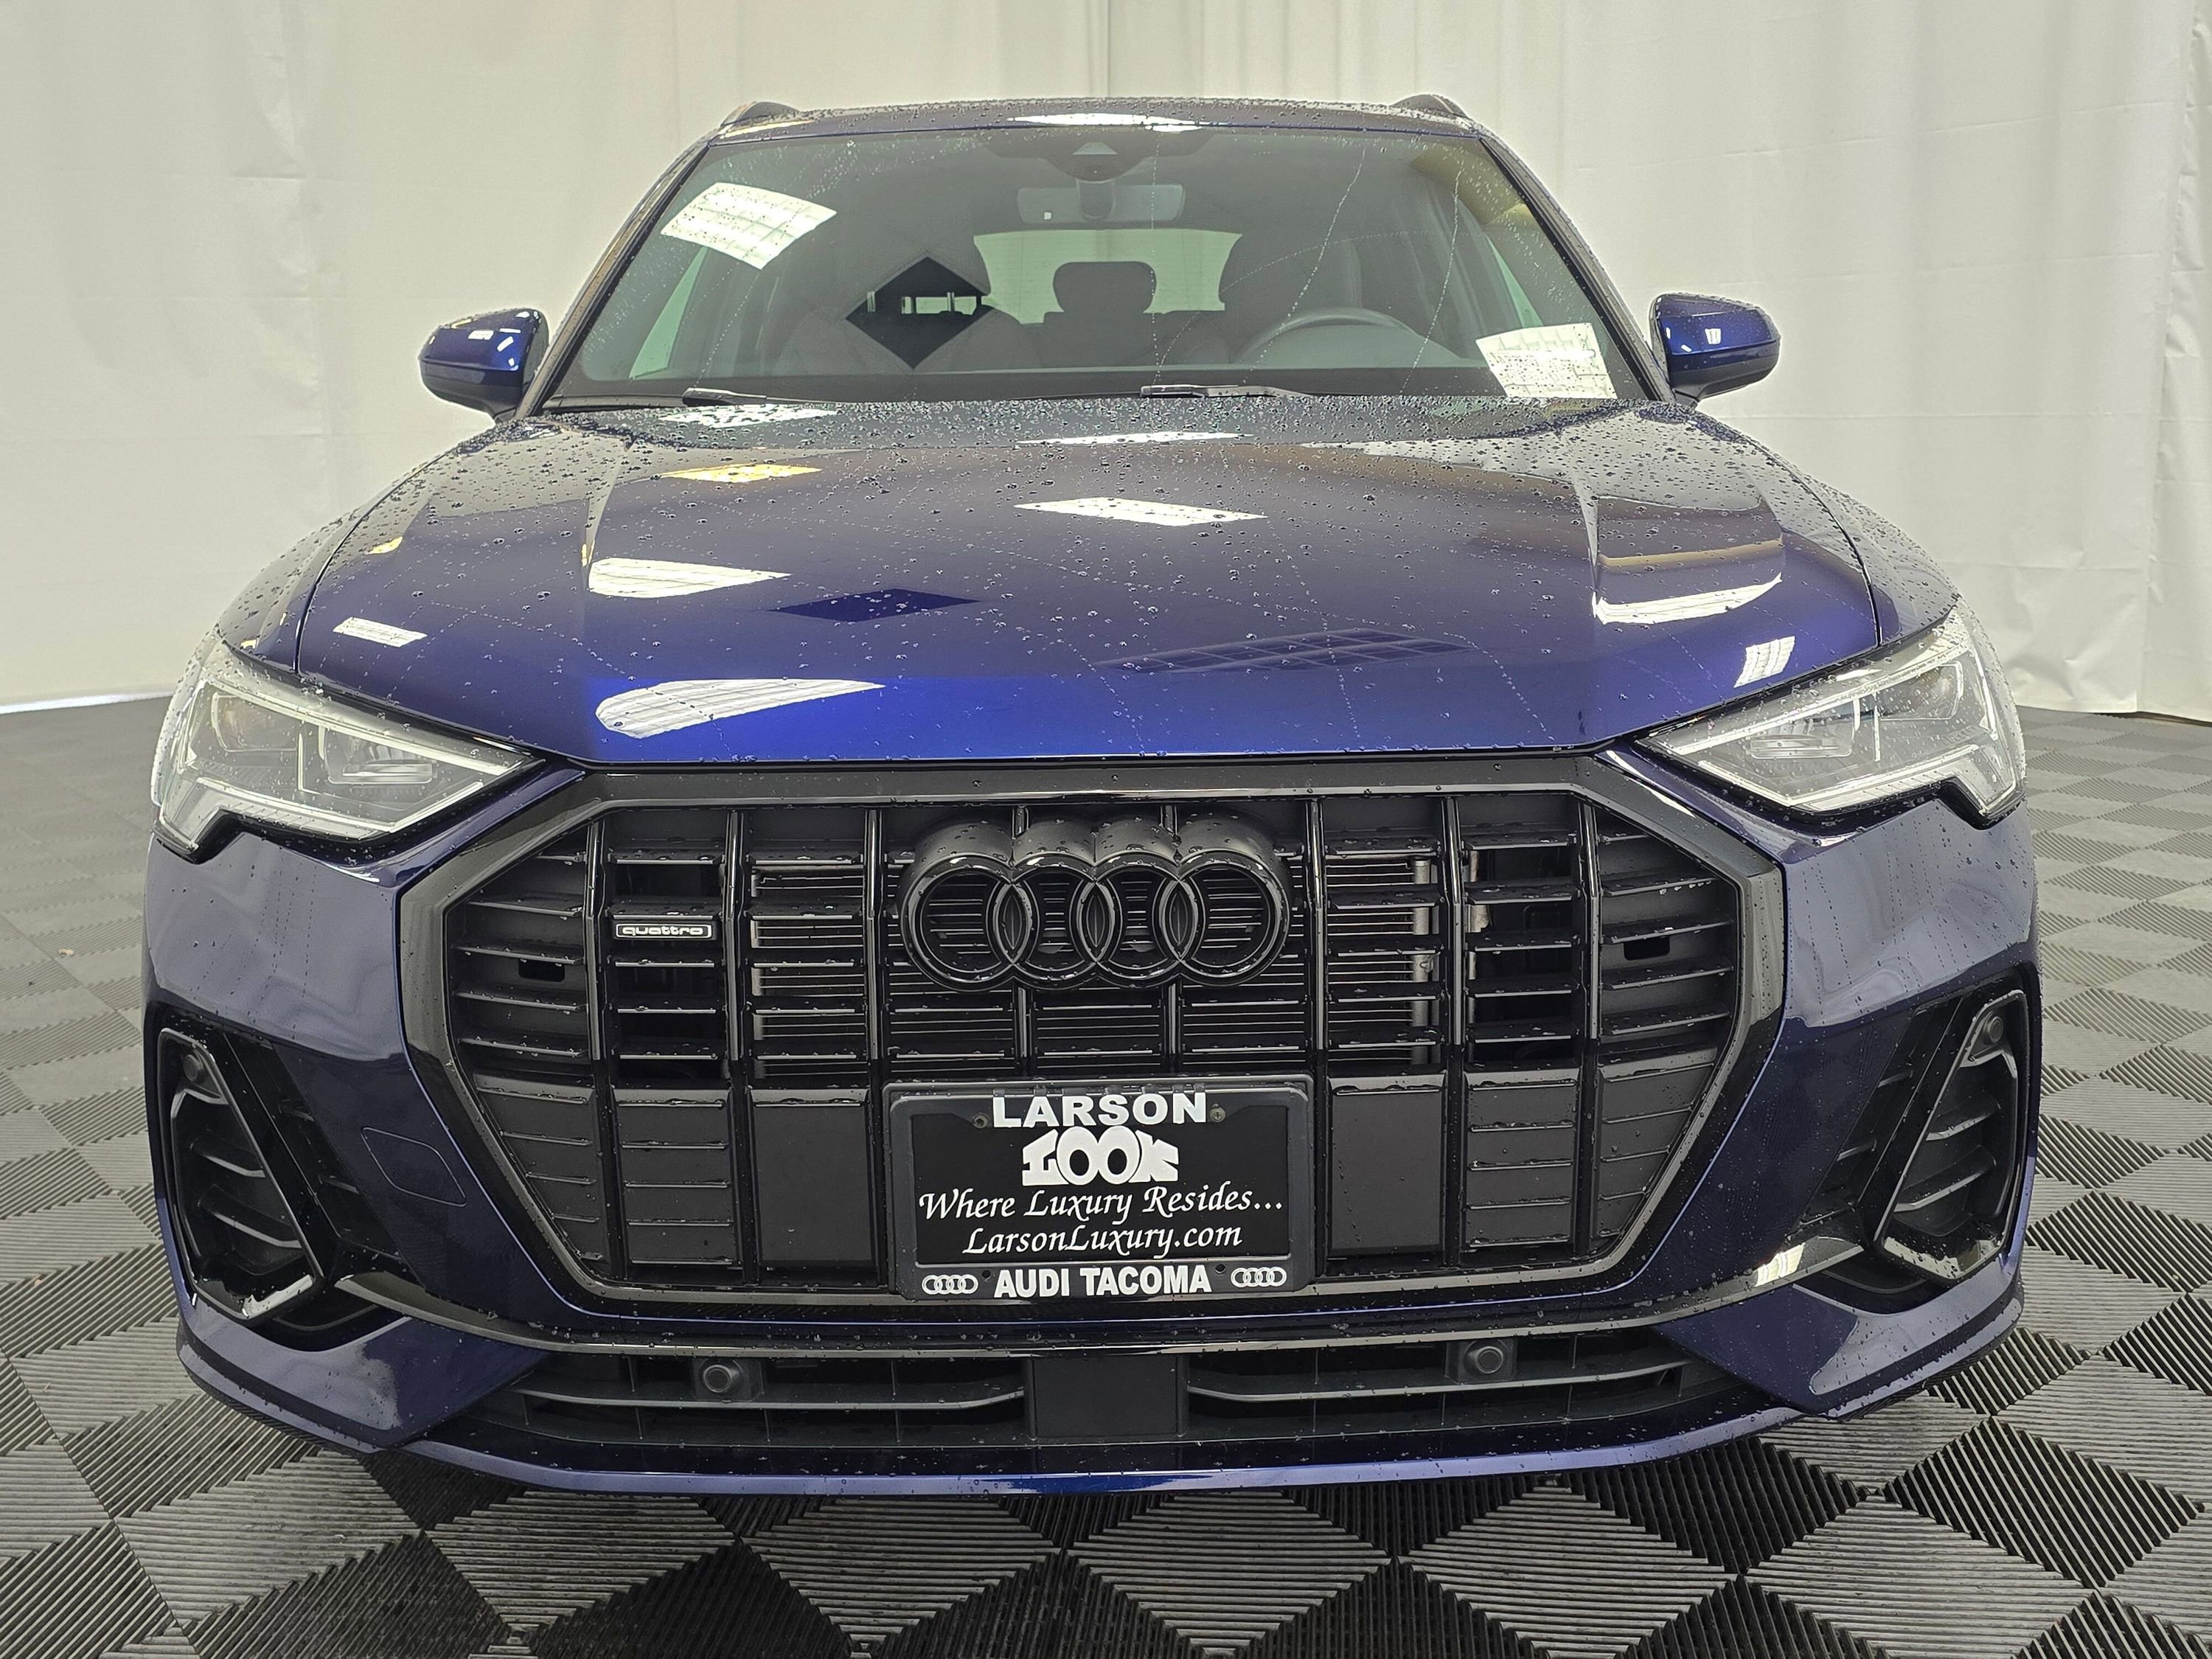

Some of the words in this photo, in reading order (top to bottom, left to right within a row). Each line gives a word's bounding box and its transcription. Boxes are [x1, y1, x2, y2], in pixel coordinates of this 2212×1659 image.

[622, 925, 703, 936] quattro
[992, 1093, 1206, 1128] LARSON
[919, 1188, 1015, 1220] Where
[1023, 1190, 1133, 1225] Luxury
[1143, 1180, 1282, 1214] Resides...
[962, 1222, 1243, 1259] LarsonLuxury.com
[994, 1269, 1070, 1298] AUDI
[1079, 1265, 1212, 1298] TACOMA
